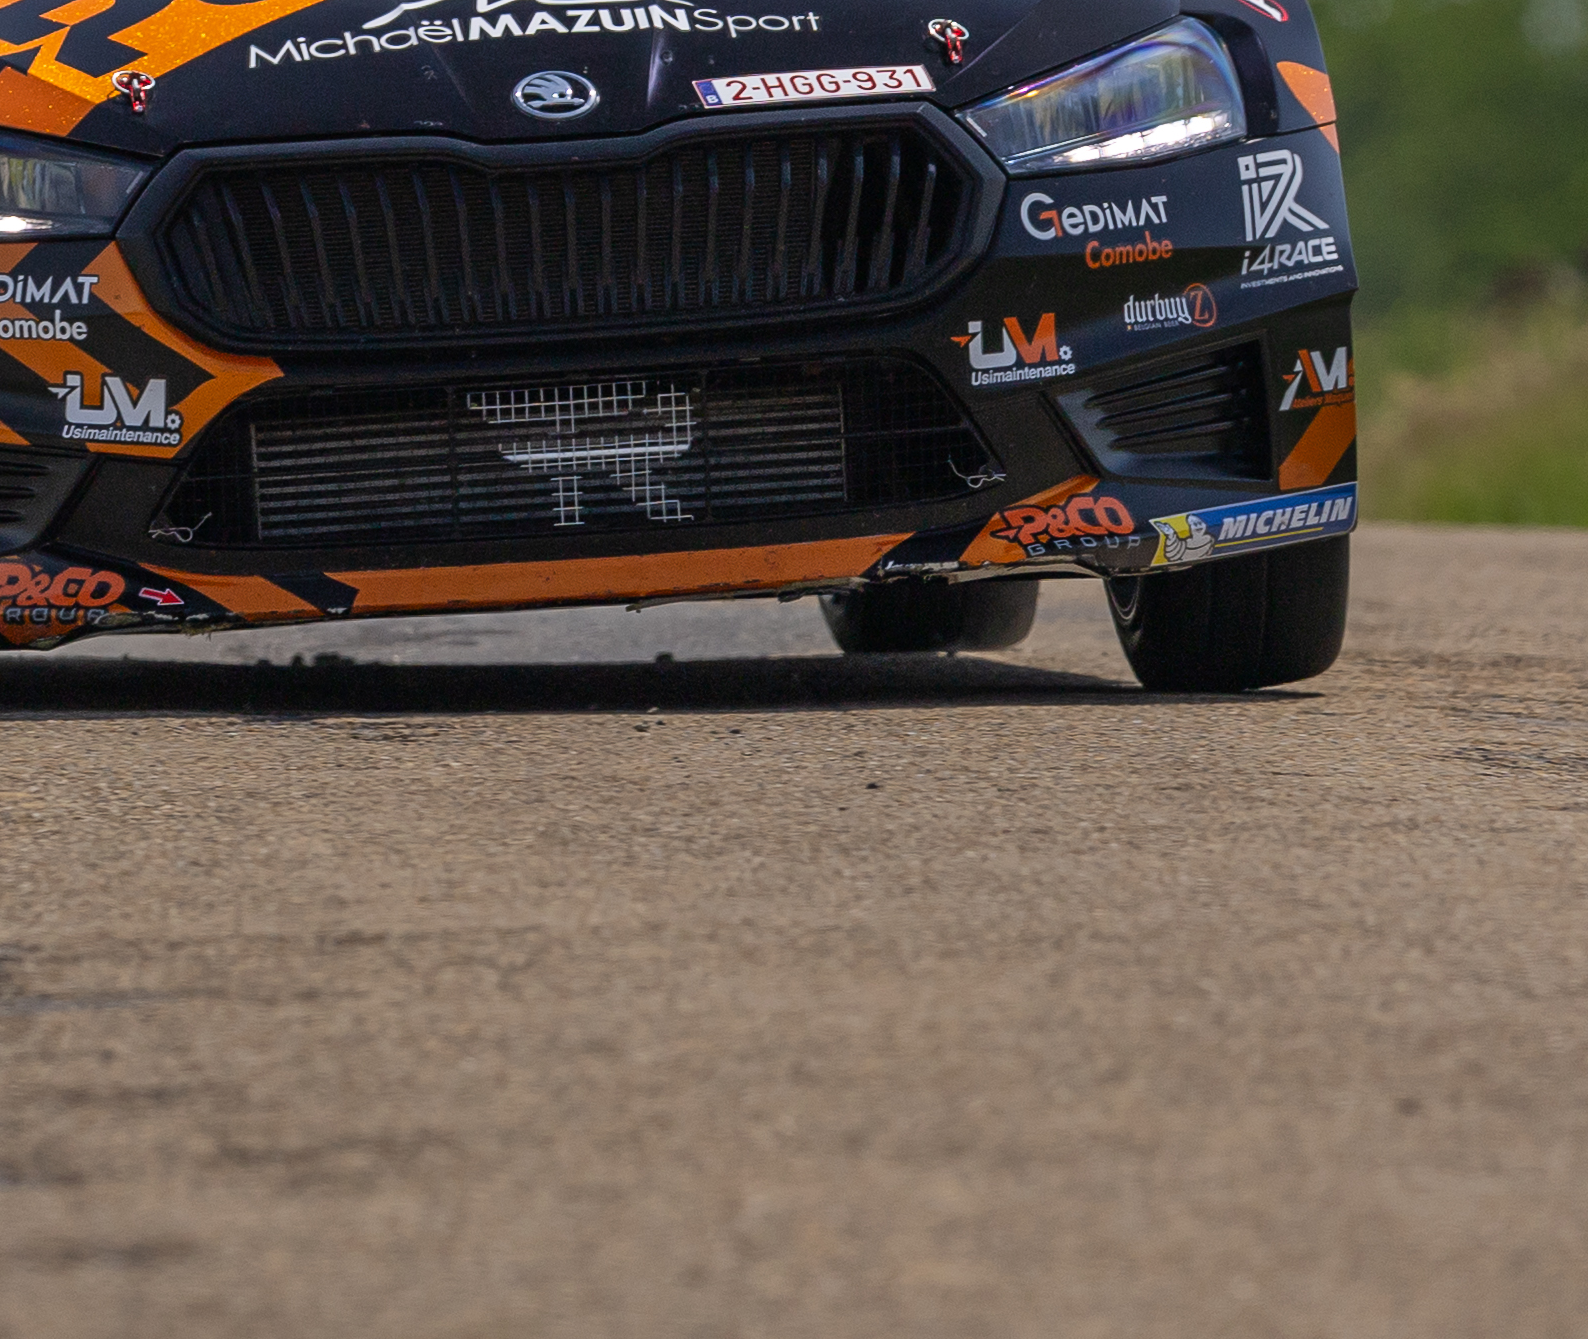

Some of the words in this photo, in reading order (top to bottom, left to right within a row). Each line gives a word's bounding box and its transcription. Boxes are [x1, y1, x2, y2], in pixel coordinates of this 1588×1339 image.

[725, 68, 922, 101] 2-HGG-931
[705, 94, 719, 104] B
[1085, 230, 1174, 269] Comobe
[971, 363, 1076, 386] Usimaintenance
[61, 425, 181, 445] Usimaintenance
[1001, 496, 1136, 545] P&CO
[1217, 496, 1353, 541] MICHELIN
[1027, 535, 1142, 557] GROUP
